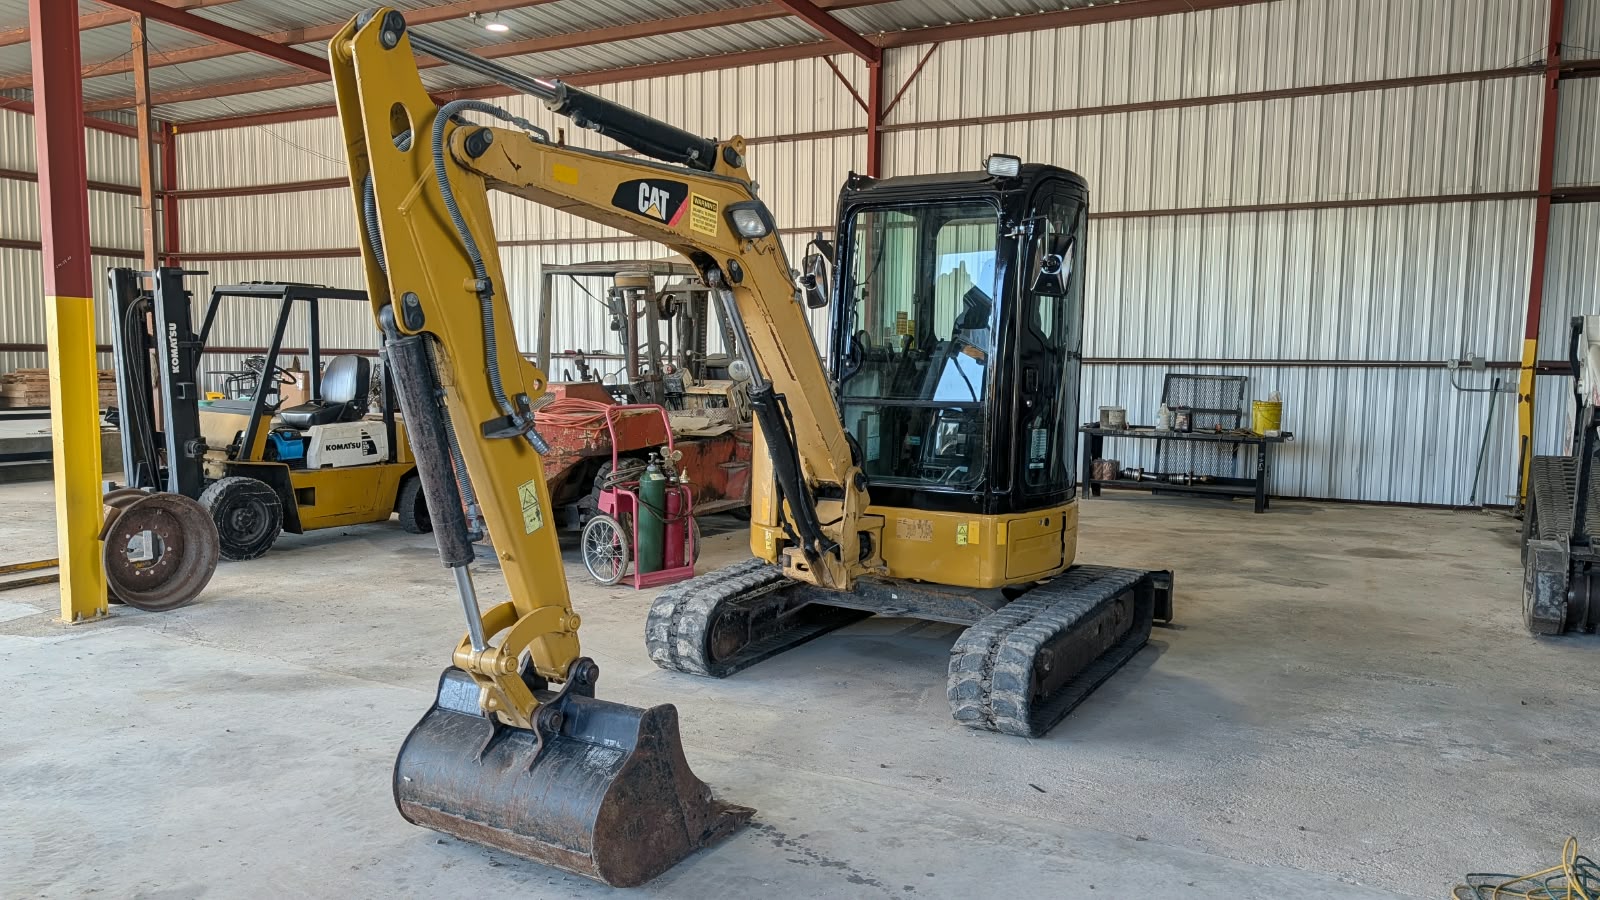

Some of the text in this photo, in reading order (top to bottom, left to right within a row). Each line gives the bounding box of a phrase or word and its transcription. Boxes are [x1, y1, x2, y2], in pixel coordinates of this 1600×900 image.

[638, 182, 670, 220] CAT
[693, 196, 717, 211] WARNING
[168, 322, 180, 374] KOMATSU
[325, 442, 361, 451] KOMATSU
